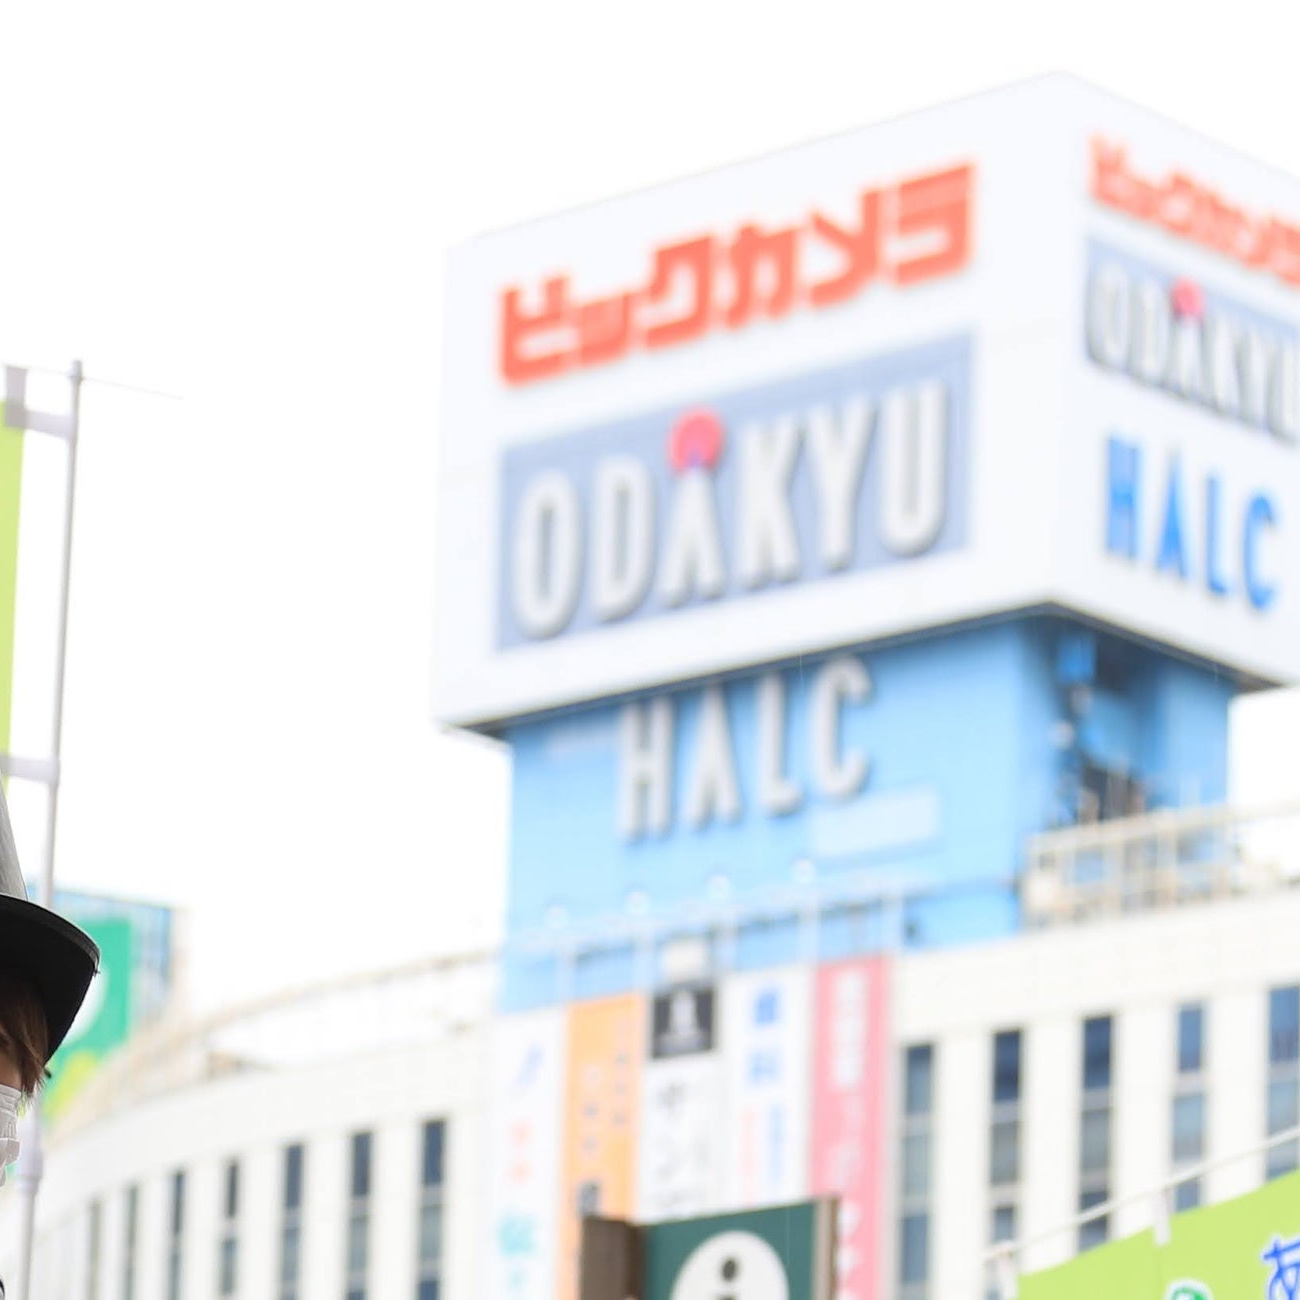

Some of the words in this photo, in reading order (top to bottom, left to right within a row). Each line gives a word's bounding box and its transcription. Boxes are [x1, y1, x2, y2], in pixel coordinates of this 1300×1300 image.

[500, 158, 978, 387] ビックカメラ
[1086, 258, 1300, 447] ODAKYU
[512, 380, 950, 640] ODAKYU
[1104, 430, 1280, 613] HALC
[619, 655, 874, 843] HALC
